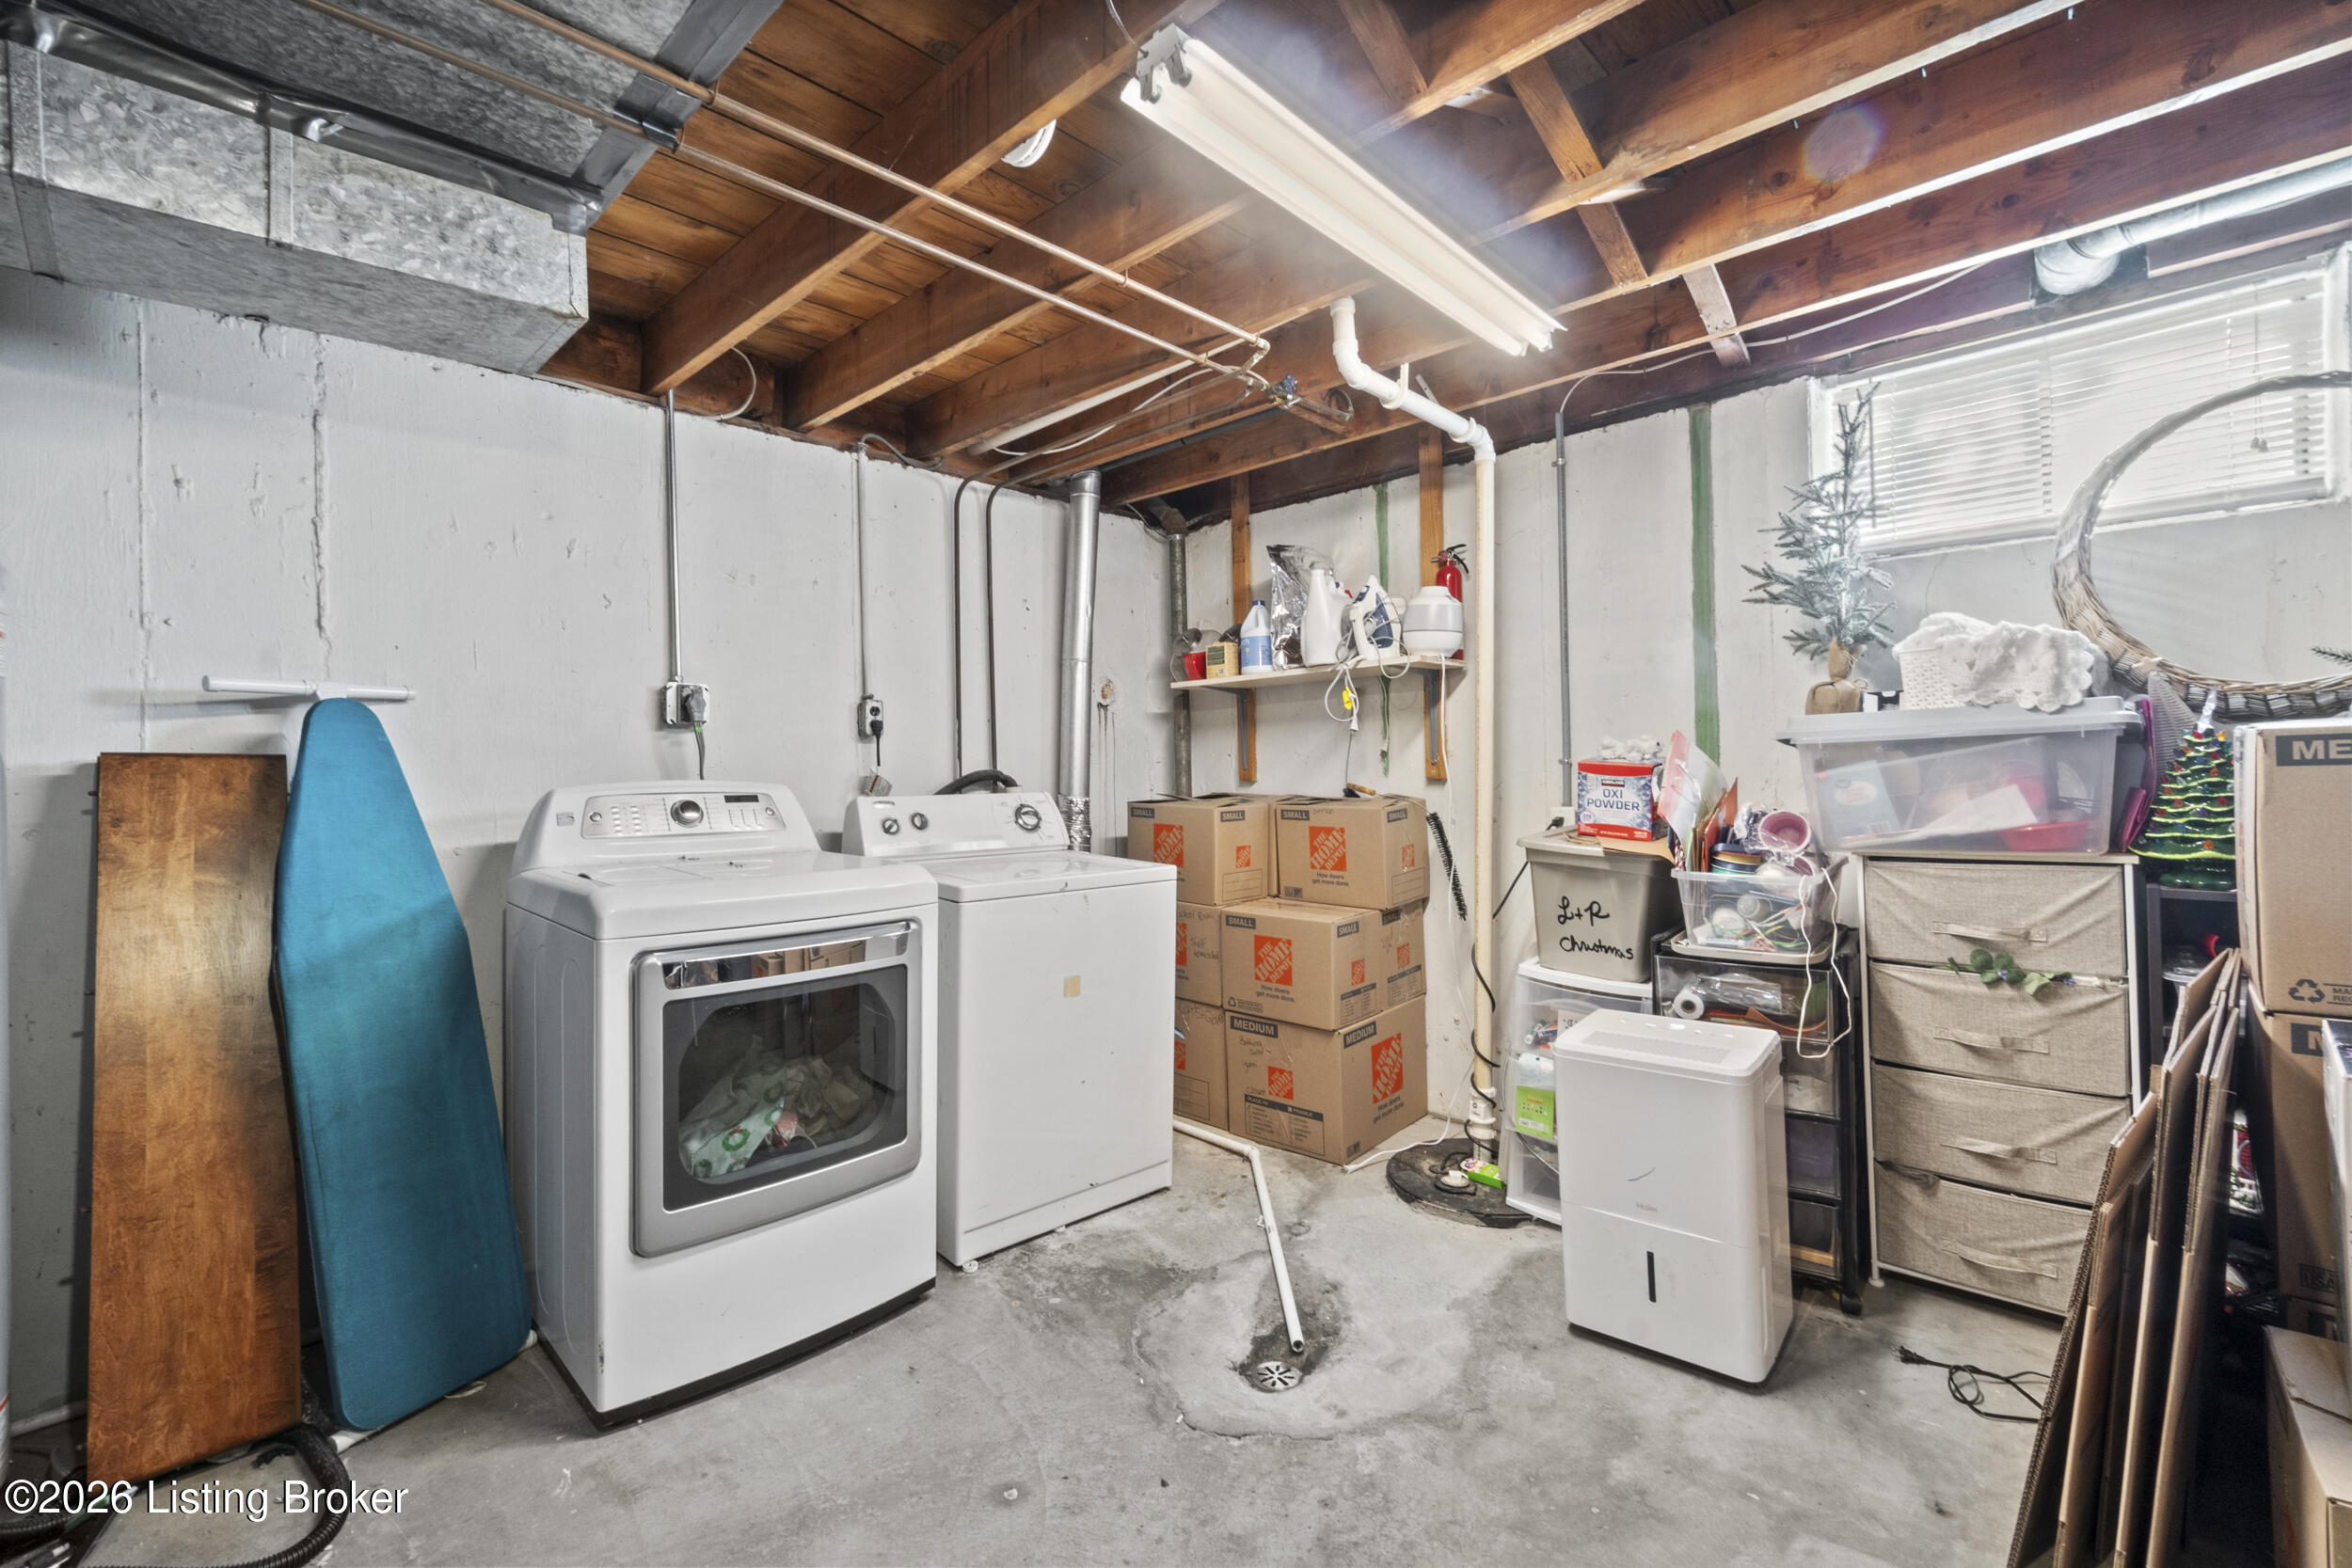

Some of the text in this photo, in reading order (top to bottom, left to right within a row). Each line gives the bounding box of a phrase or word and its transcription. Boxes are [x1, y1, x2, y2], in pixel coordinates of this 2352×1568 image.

[1602, 788, 1623, 799] OXI
[1132, 808, 1153, 817] SMALL
[1586, 798, 1640, 811] POWDER
[1222, 811, 1244, 820] SMALL
[1282, 811, 1308, 820] SMALL
[1388, 810, 1407, 821] SMALL
[1312, 830, 1328, 847] THE
[1310, 827, 1346, 870] HOME
[1324, 844, 1346, 871] DEPOT
[1228, 916, 1254, 927] SMALL
[1338, 922, 1358, 935] SMALL
[1257, 941, 1274, 958] THE
[1559, 934, 1633, 959] Christmas
[1255, 938, 1293, 981] HOME
[1269, 957, 1294, 984] DEPOT
[1233, 1019, 1274, 1036] MEDIUM
[1345, 1023, 1375, 1046] MEDIUM
[1373, 1034, 1402, 1101] HOME
[1385, 1055, 1403, 1096] DEPOT
[1268, 1069, 1293, 1098] HOME
